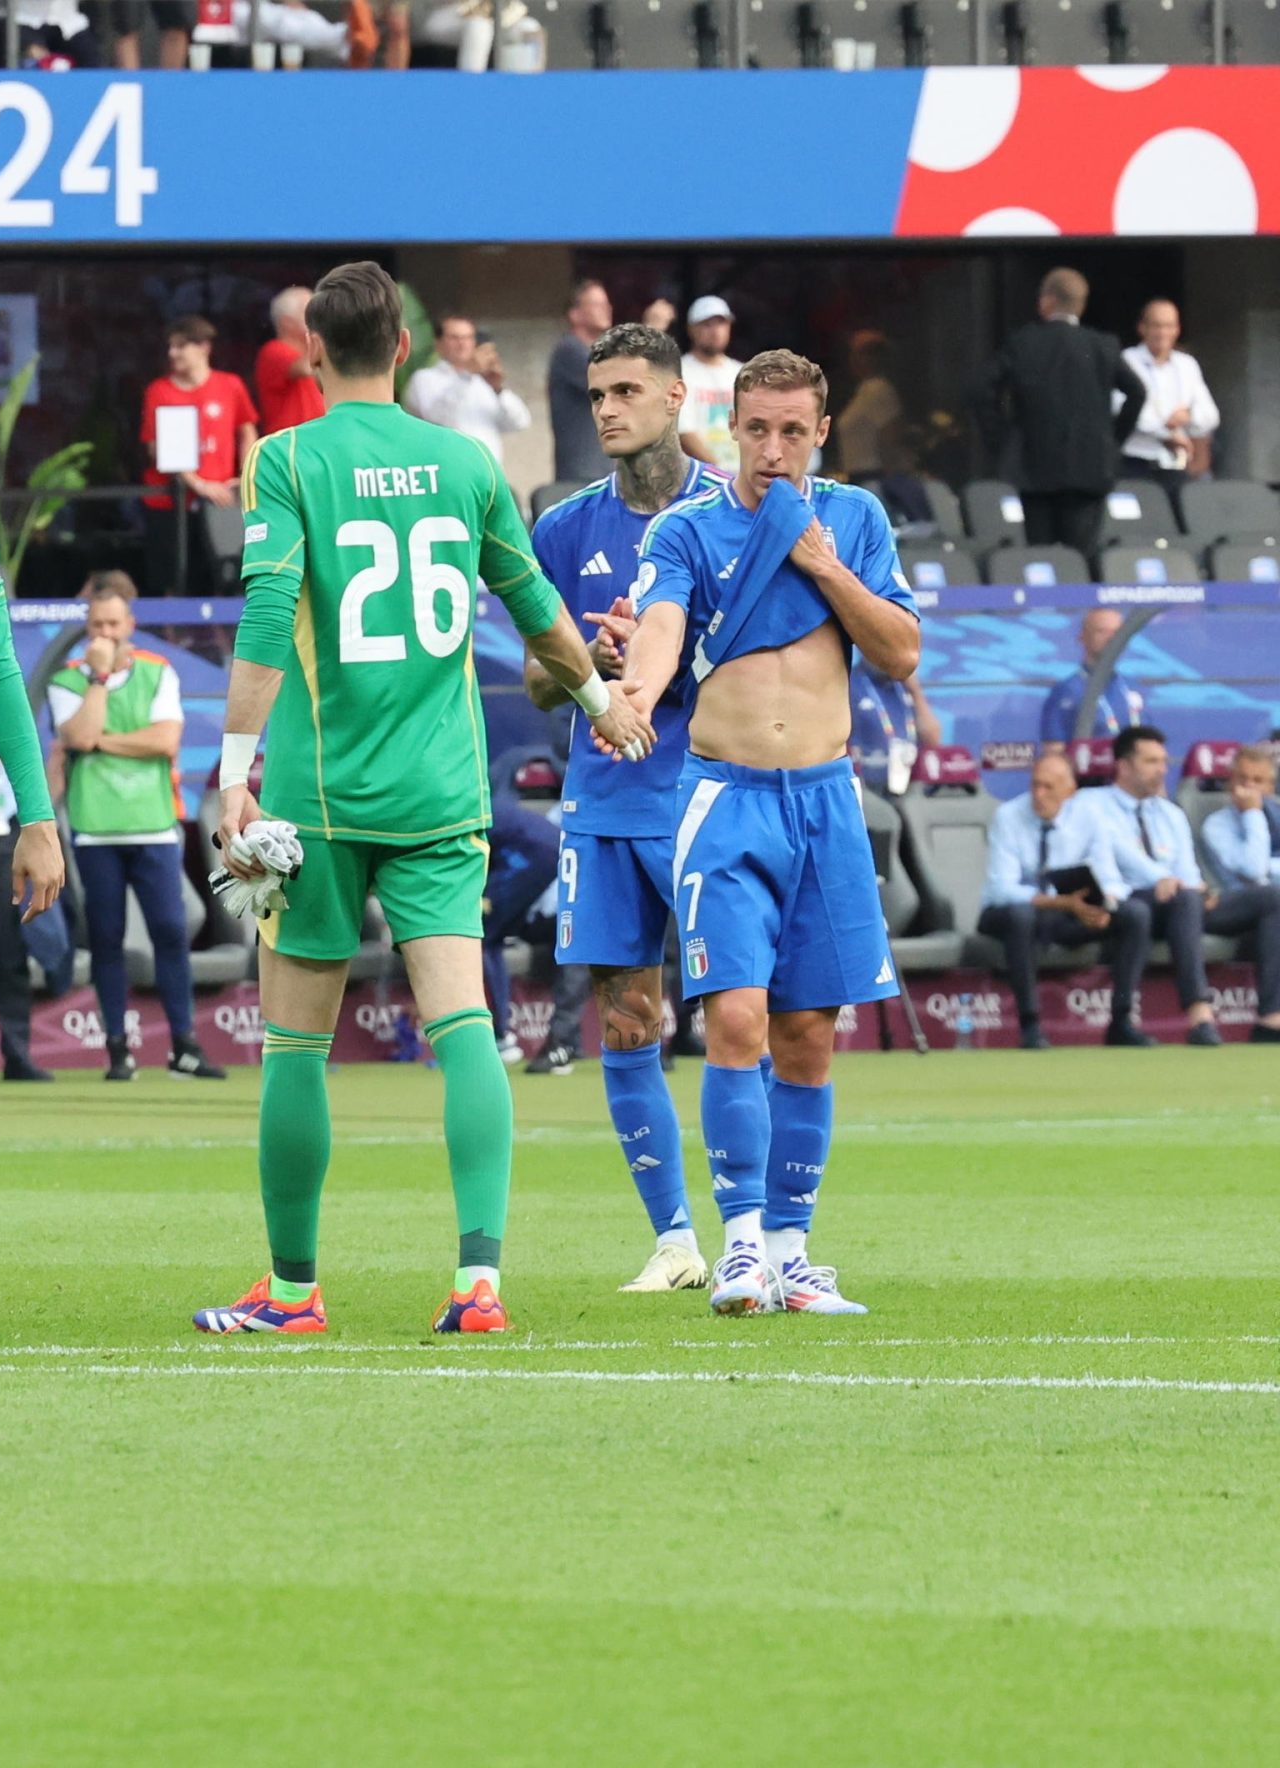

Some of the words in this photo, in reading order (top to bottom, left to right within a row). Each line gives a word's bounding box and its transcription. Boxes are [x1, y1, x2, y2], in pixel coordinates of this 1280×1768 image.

[353, 464, 439, 497] MERET
[335, 516, 470, 663] 26
[561, 848, 578, 903] 9
[682, 872, 703, 932] 7
[926, 993, 1002, 1021] QAAR
